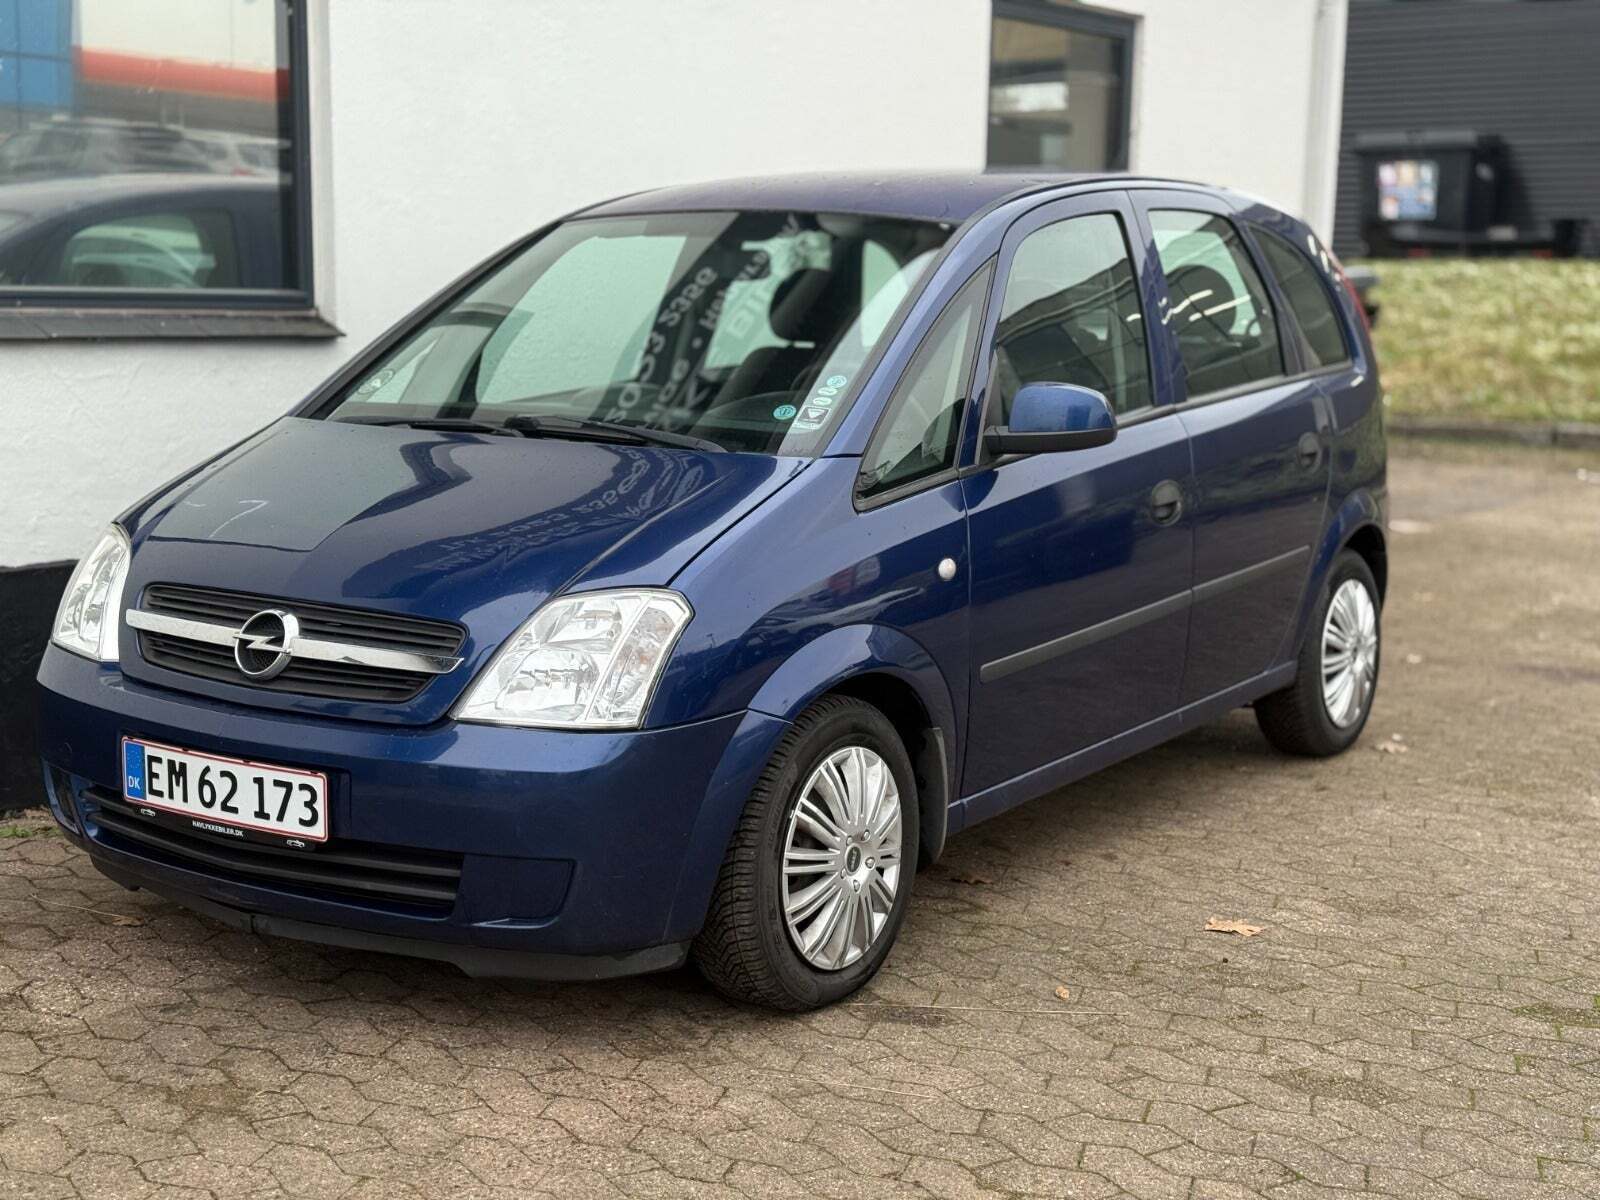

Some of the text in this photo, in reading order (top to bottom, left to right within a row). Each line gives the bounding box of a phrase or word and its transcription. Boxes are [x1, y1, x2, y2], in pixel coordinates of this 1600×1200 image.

[128, 775, 141, 791] DK
[147, 754, 319, 828] EM 62 173
